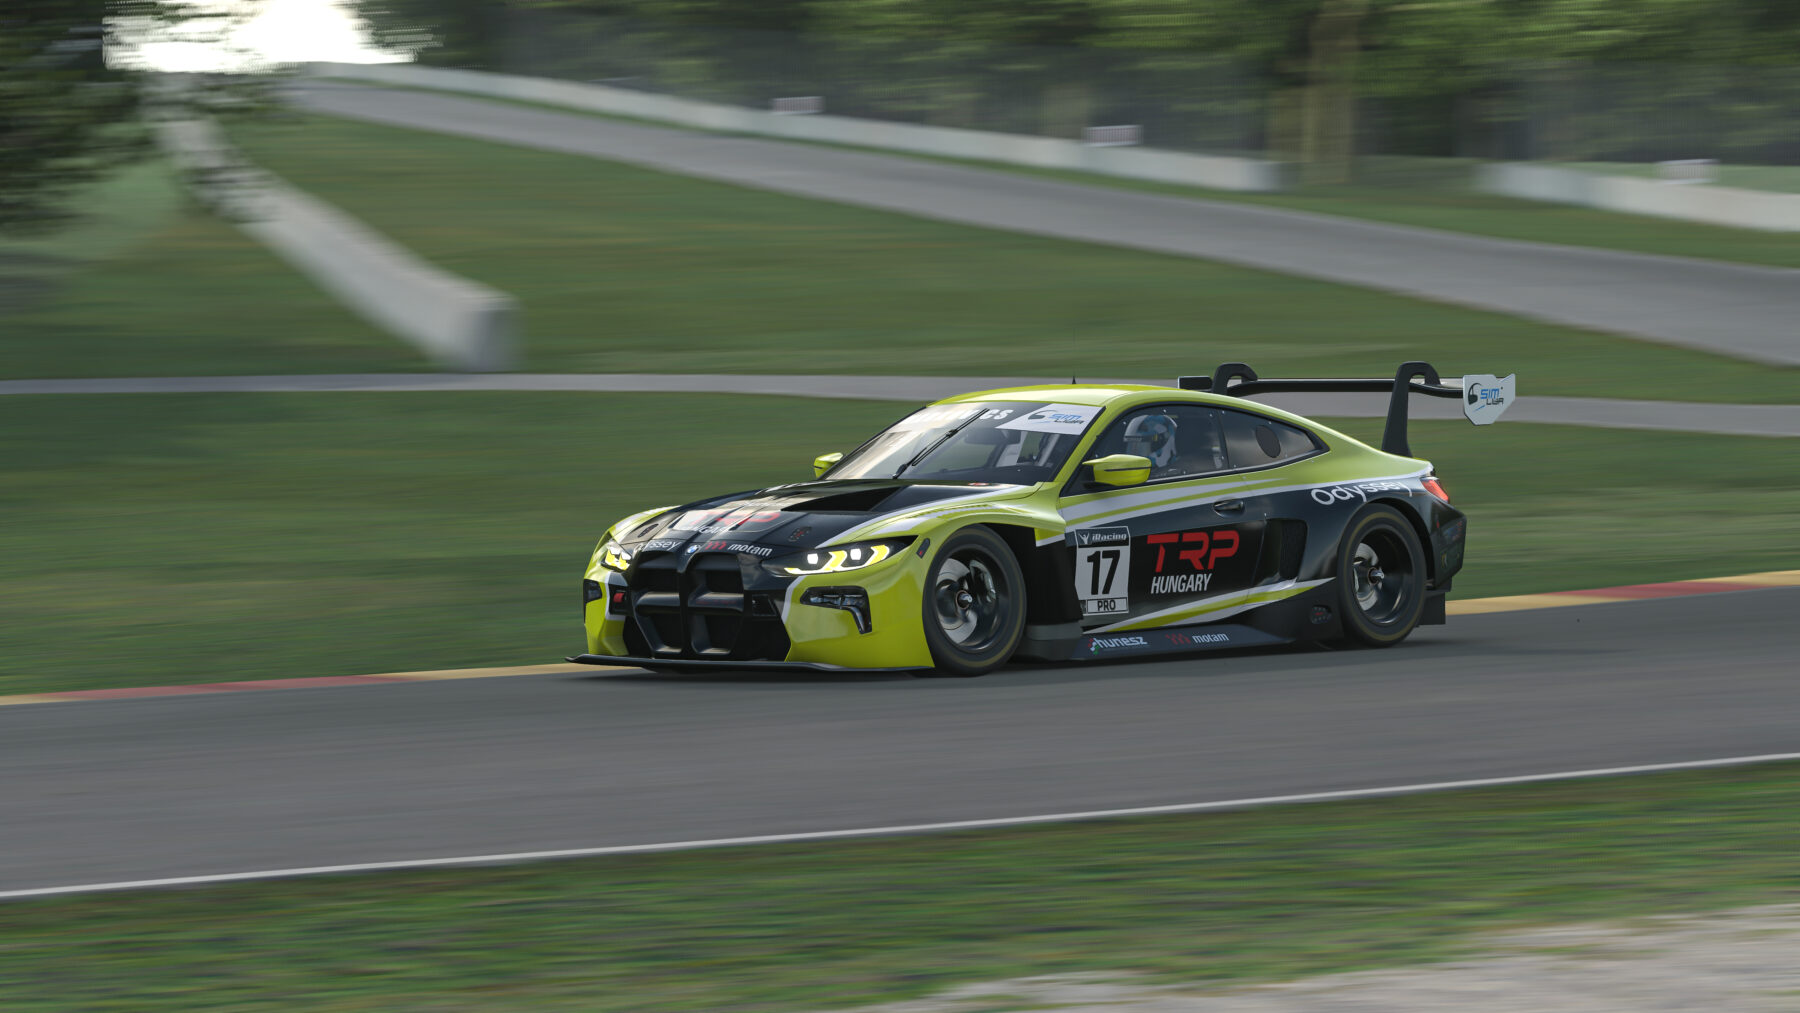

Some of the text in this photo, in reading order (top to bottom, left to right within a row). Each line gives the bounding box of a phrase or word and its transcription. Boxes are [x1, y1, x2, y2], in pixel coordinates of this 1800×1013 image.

[1480, 388, 1500, 400] SIM
[1311, 480, 1413, 506] Odyssey
[1092, 533, 1127, 541] iRacing
[727, 543, 773, 556] motam
[1147, 530, 1240, 573] TRP
[1087, 550, 1121, 596] 17
[1151, 573, 1212, 595] HUNGARY
[1097, 600, 1116, 611] PRO
[1095, 636, 1148, 649] hunesz
[1192, 632, 1230, 644] motam
